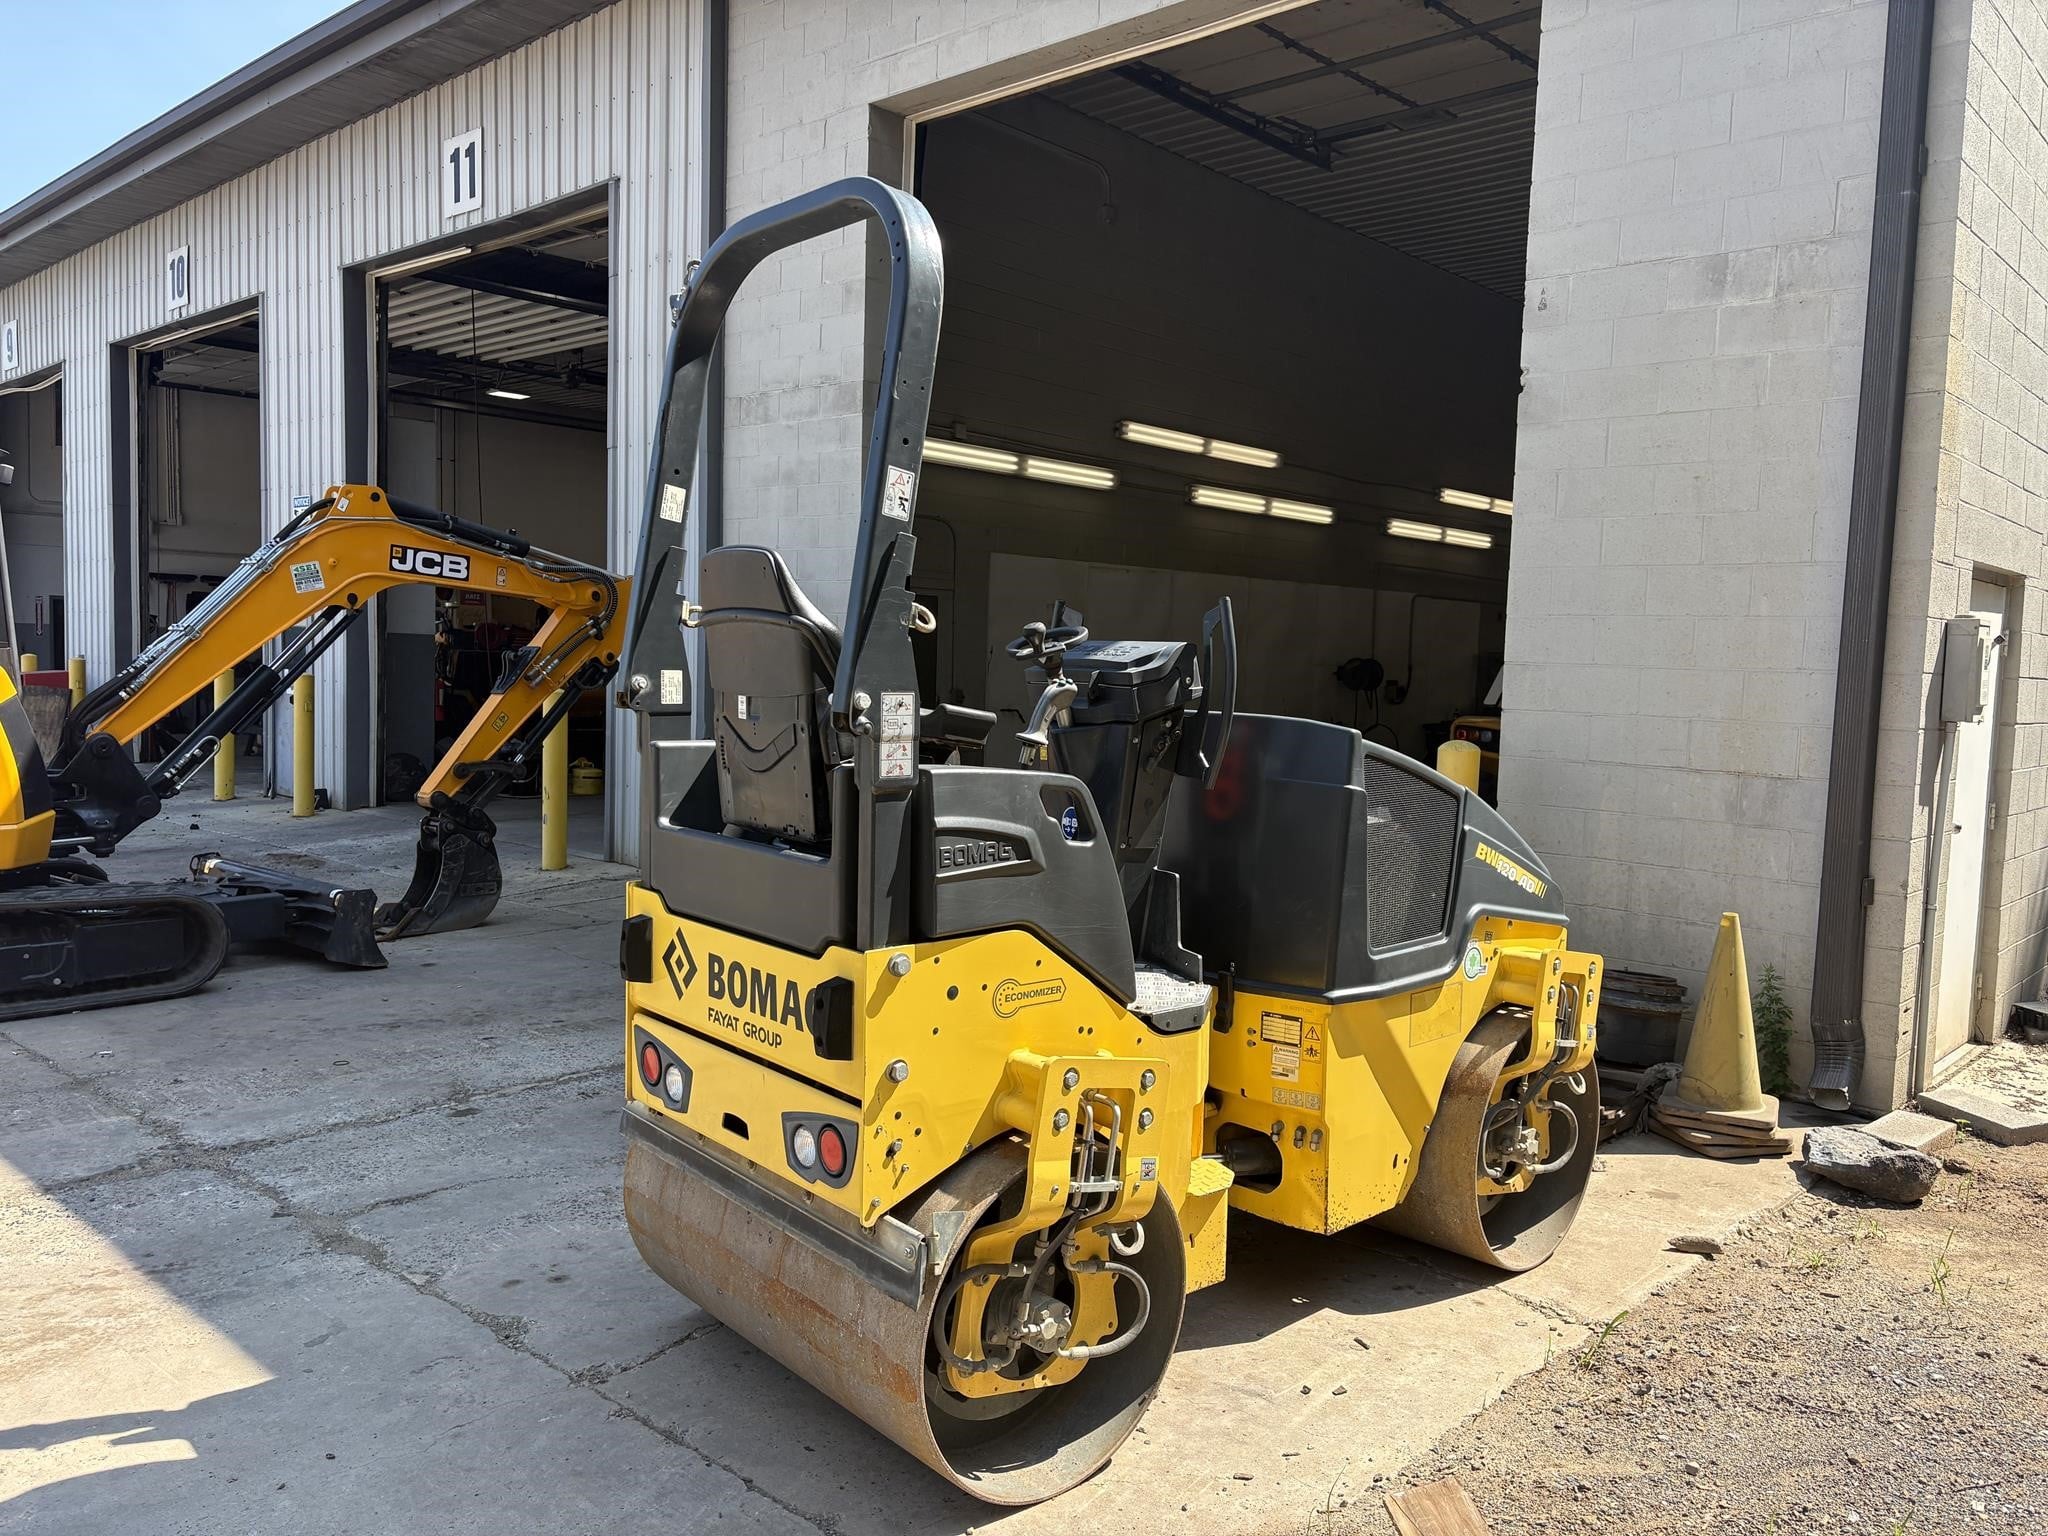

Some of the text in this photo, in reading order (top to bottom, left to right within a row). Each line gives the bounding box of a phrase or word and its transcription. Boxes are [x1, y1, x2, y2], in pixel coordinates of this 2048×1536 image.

[449, 141, 477, 205] 11
[169, 255, 185, 301] 10
[6, 327, 14, 364] 9
[391, 548, 468, 580] JCB
[939, 841, 1013, 870] BOMAG
[1004, 985, 1062, 1003] ECONOMIZER
[708, 1007, 783, 1049] FAYAT GROUP
